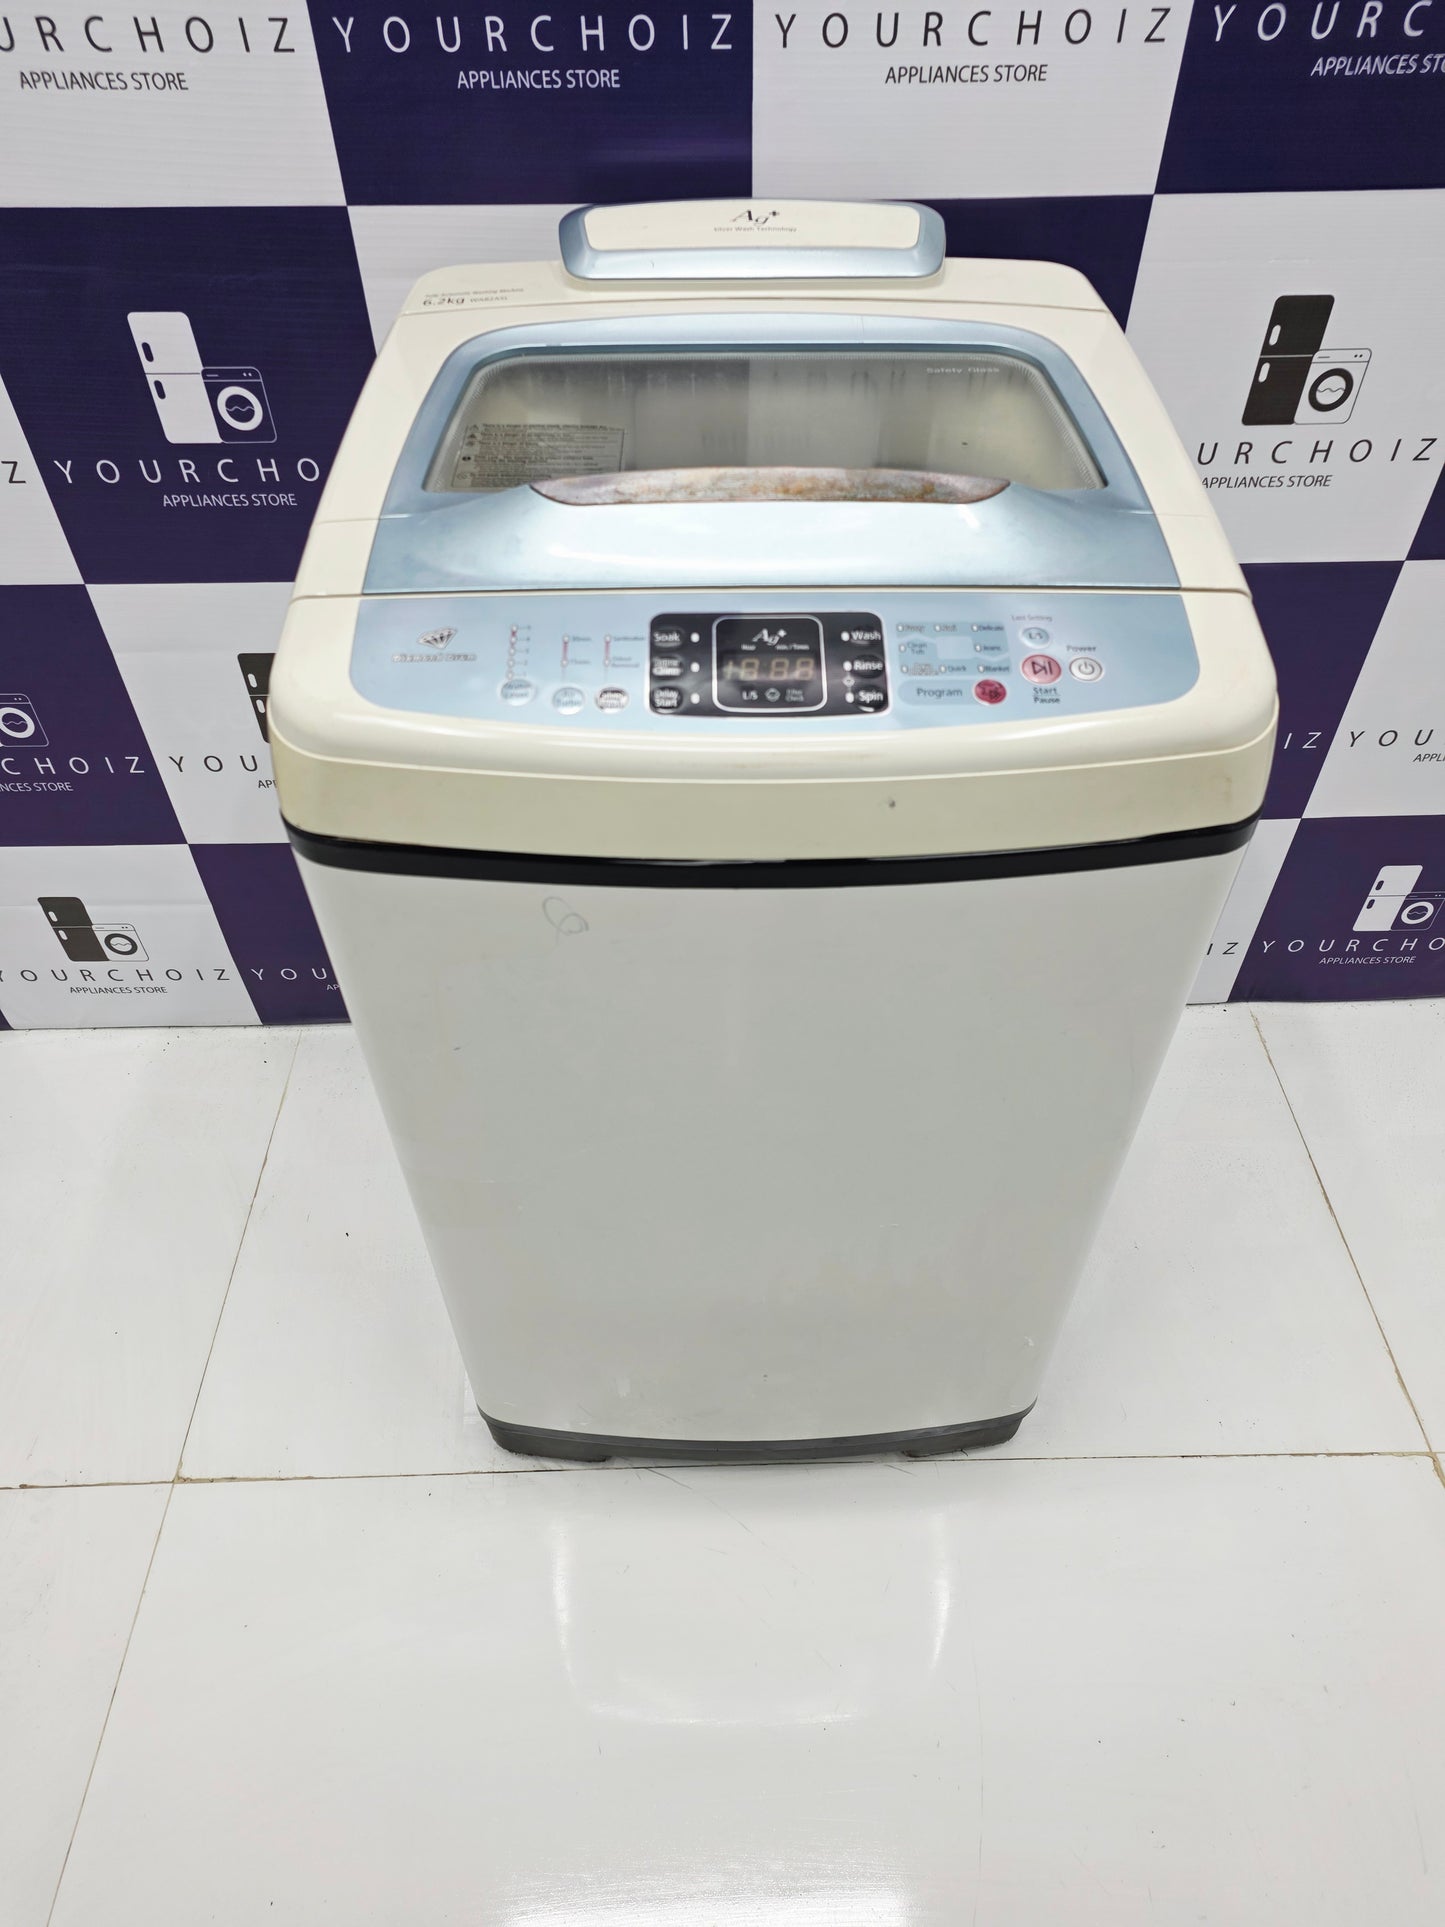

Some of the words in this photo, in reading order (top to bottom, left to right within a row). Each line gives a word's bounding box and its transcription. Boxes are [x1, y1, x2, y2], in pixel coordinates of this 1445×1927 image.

[332, 14, 732, 53] YOURCHOIZ
[774, 8, 1171, 49] YOURCHOIZ
[1310, 54, 1420, 77] APPLIANCES
[19, 71, 128, 90] APPLIANCES
[130, 72, 190, 91] STORE
[457, 69, 562, 89] APPLIANCES
[566, 69, 620, 88] STORE
[885, 65, 989, 84] APPLIANCES
[992, 64, 1048, 82] STORE
[1202, 474, 1284, 489] APPLIANCES
[1287, 473, 1333, 488] STORE
[163, 494, 249, 508] APPLIANCES
[252, 493, 298, 507] STORE
[850, 630, 881, 641] Wash
[853, 660, 884, 671] Rinse
[859, 689, 884, 704] Spin
[916, 687, 963, 699] Program
[1032, 687, 1058, 695] Start
[1033, 696, 1061, 704] Pause
[33, 782, 74, 792] STORE
[1319, 956, 1381, 965] APPLIANCES
[1383, 955, 1417, 964] STORE
[70, 986, 132, 994] APPLIANCES
[133, 986, 168, 994] STORE
